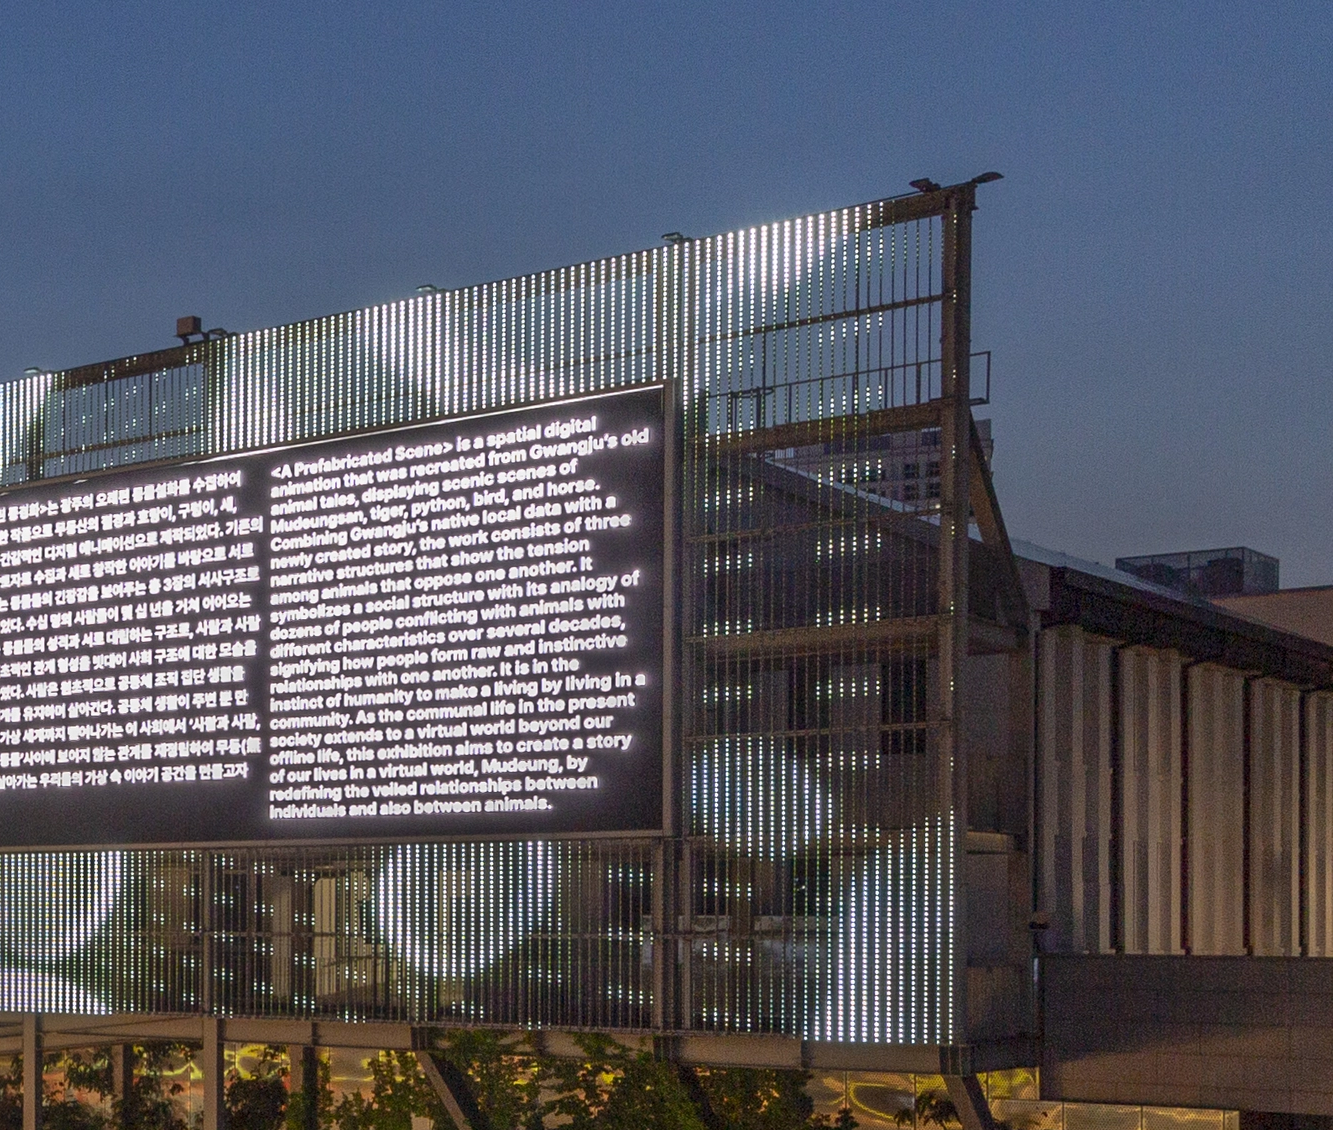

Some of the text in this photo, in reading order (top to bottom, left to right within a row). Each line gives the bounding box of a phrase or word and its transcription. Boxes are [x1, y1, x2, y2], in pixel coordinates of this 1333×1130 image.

[271, 477, 340, 496] animation
[343, 470, 373, 486] that
[376, 468, 406, 481] was
[410, 453, 484, 476] recreated
[488, 451, 525, 465] from
[621, 429, 648, 446] old
[295, 448, 391, 475] Prefabricated
[457, 437, 469, 451] is
[473, 438, 483, 448] a
[487, 425, 540, 449] spatial
[544, 417, 595, 439] digital
[512, 484, 543, 500] and
[271, 552, 312, 568] newly
[315, 544, 370, 563] created
[420, 536, 445, 550] the
[449, 529, 487, 547] work
[491, 522, 559, 542] consists
[564, 518, 580, 533] of
[585, 515, 630, 530] three
[271, 539, 589, 586] narrative structures that show the tension
[270, 571, 638, 624] symbolizes a social structure with its analogy of
[356, 710, 374, 723] As
[378, 708, 403, 722] the
[407, 702, 486, 720] communal
[491, 700, 514, 715] life
[519, 699, 533, 713] in
[538, 697, 564, 712] the
[569, 693, 634, 714] present
[270, 769, 283, 783] of
[287, 771, 310, 782] our
[314, 767, 346, 781] lives
[350, 766, 362, 779] in
[367, 768, 375, 778] a
[379, 762, 426, 778] virtual
[567, 755, 587, 773] by
[270, 803, 345, 818] individuals
[349, 802, 375, 816] and
[380, 801, 410, 815] also
[414, 800, 480, 813] between
